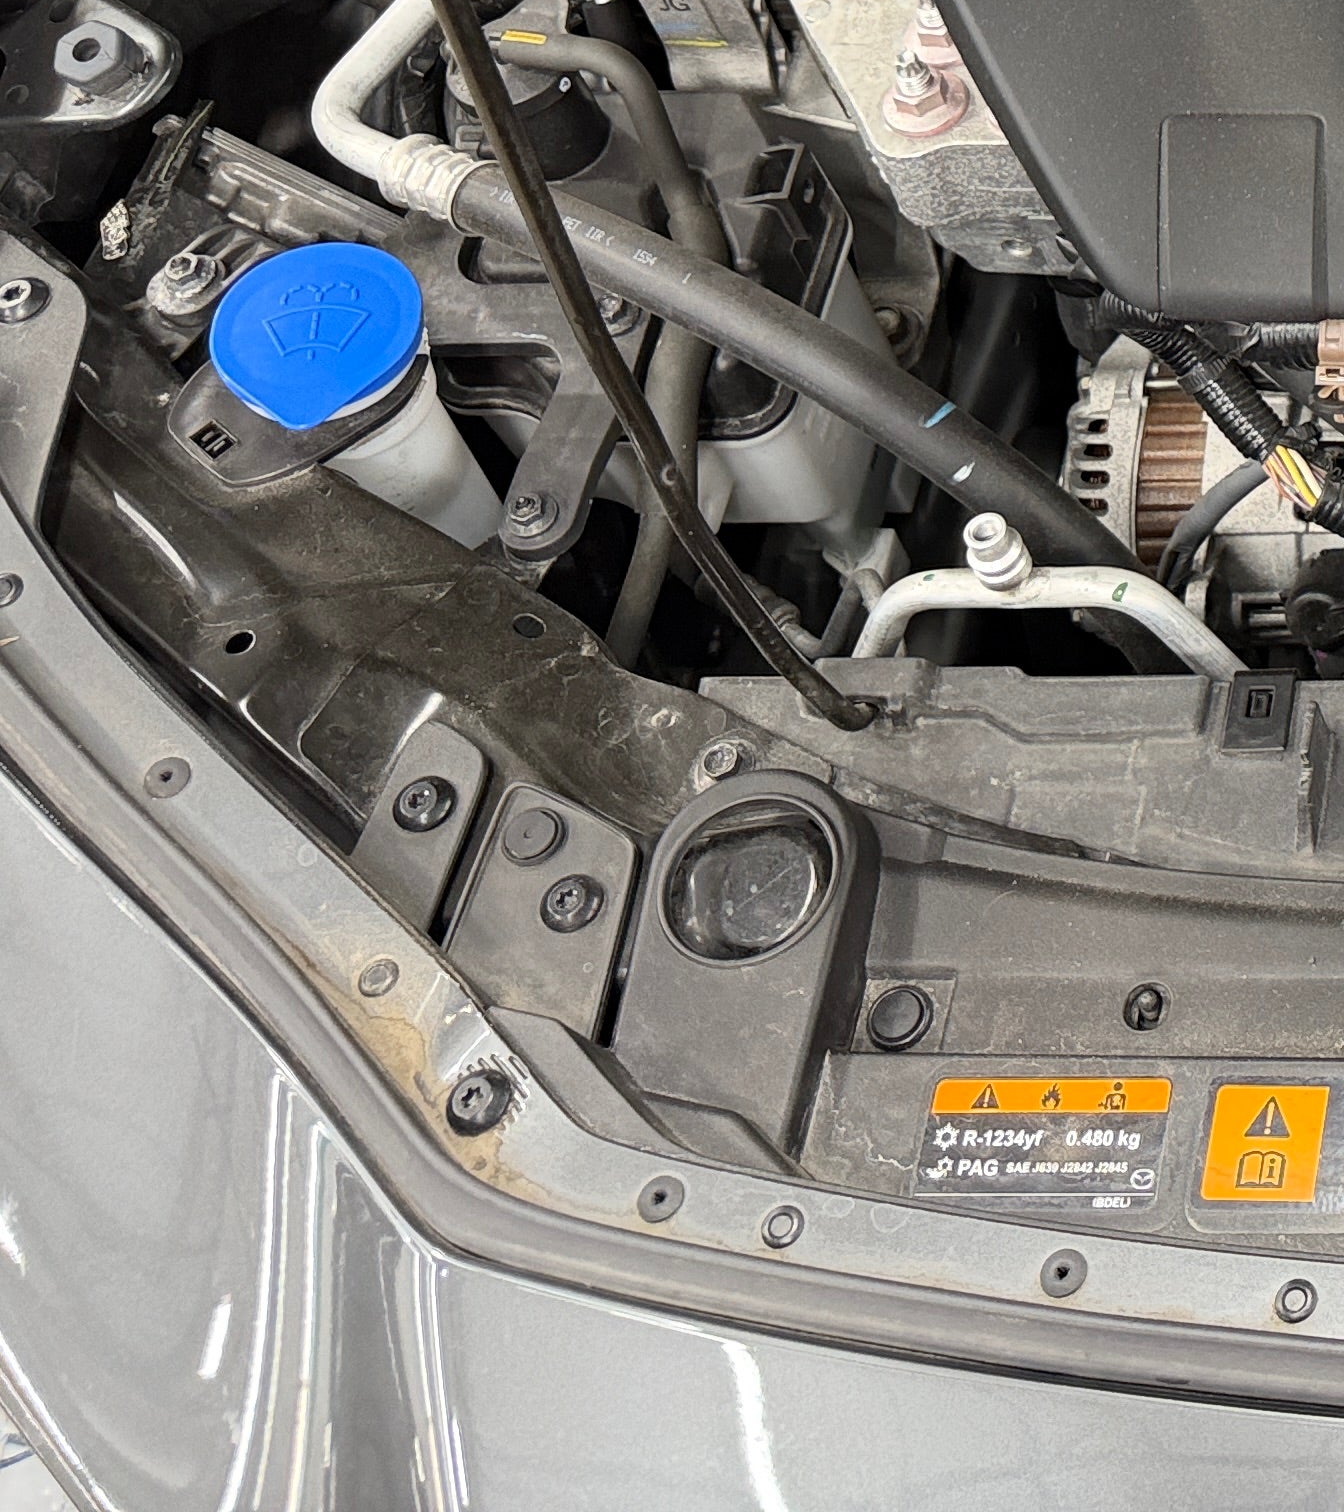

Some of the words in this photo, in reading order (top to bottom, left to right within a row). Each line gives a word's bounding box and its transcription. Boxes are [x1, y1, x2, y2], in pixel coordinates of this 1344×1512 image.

[962, 1128, 1044, 1150] R-1234yf
[1065, 1129, 1114, 1146] 0.480
[1117, 1129, 1141, 1150] kg
[956, 1159, 999, 1176] PAG
[1005, 1162, 1030, 1173] SAE
[1060, 1162, 1094, 1174] J2842
